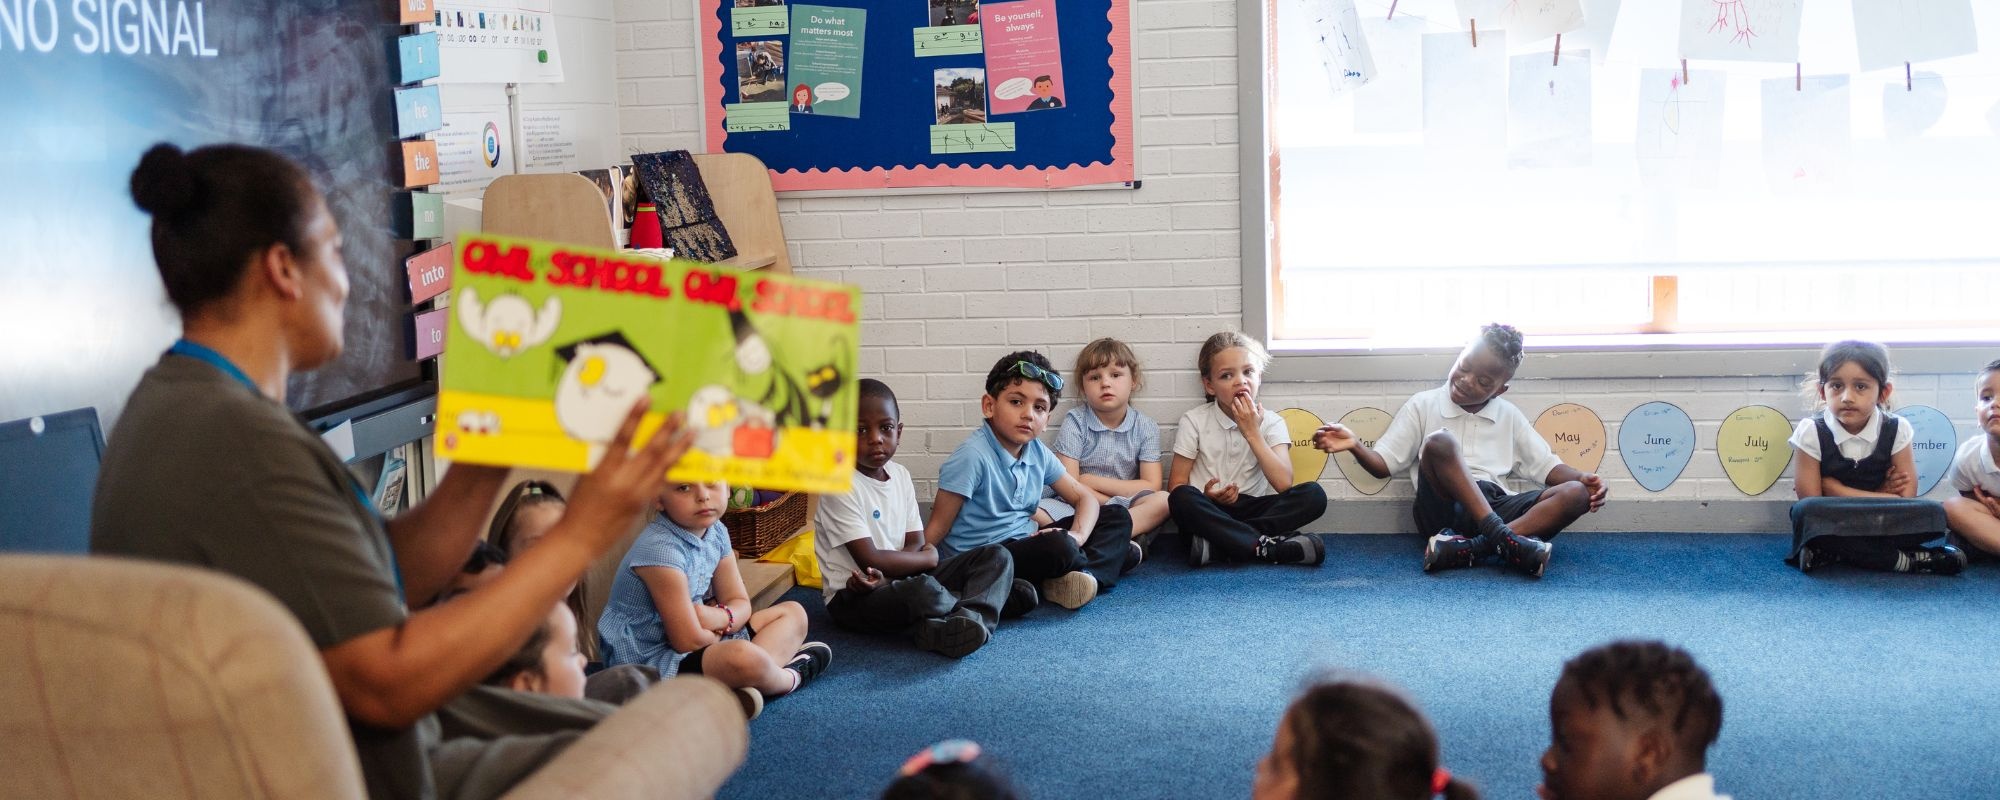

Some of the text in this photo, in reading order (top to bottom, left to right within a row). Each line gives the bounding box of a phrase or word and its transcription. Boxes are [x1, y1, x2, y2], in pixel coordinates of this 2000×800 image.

[408, 0, 426, 12] was
[810, 15, 845, 26] Do what
[994, 9, 1044, 23] Be yourself,
[0, 0, 218, 56] NO SIGNAL
[800, 27, 854, 37] matters most
[1005, 22, 1035, 33] always
[416, 46, 424, 64] I
[414, 101, 429, 119] he
[415, 152, 430, 171] the
[424, 210, 435, 223] no
[421, 265, 445, 287] into
[463, 239, 535, 282] OWL
[546, 251, 671, 299] SCHOOL
[751, 278, 857, 325] SCHOOL
[432, 327, 442, 343] to
[1555, 432, 1580, 445] May
[1644, 433, 1672, 445] June
[1744, 436, 1769, 451] July
[1912, 439, 1948, 450] ember
